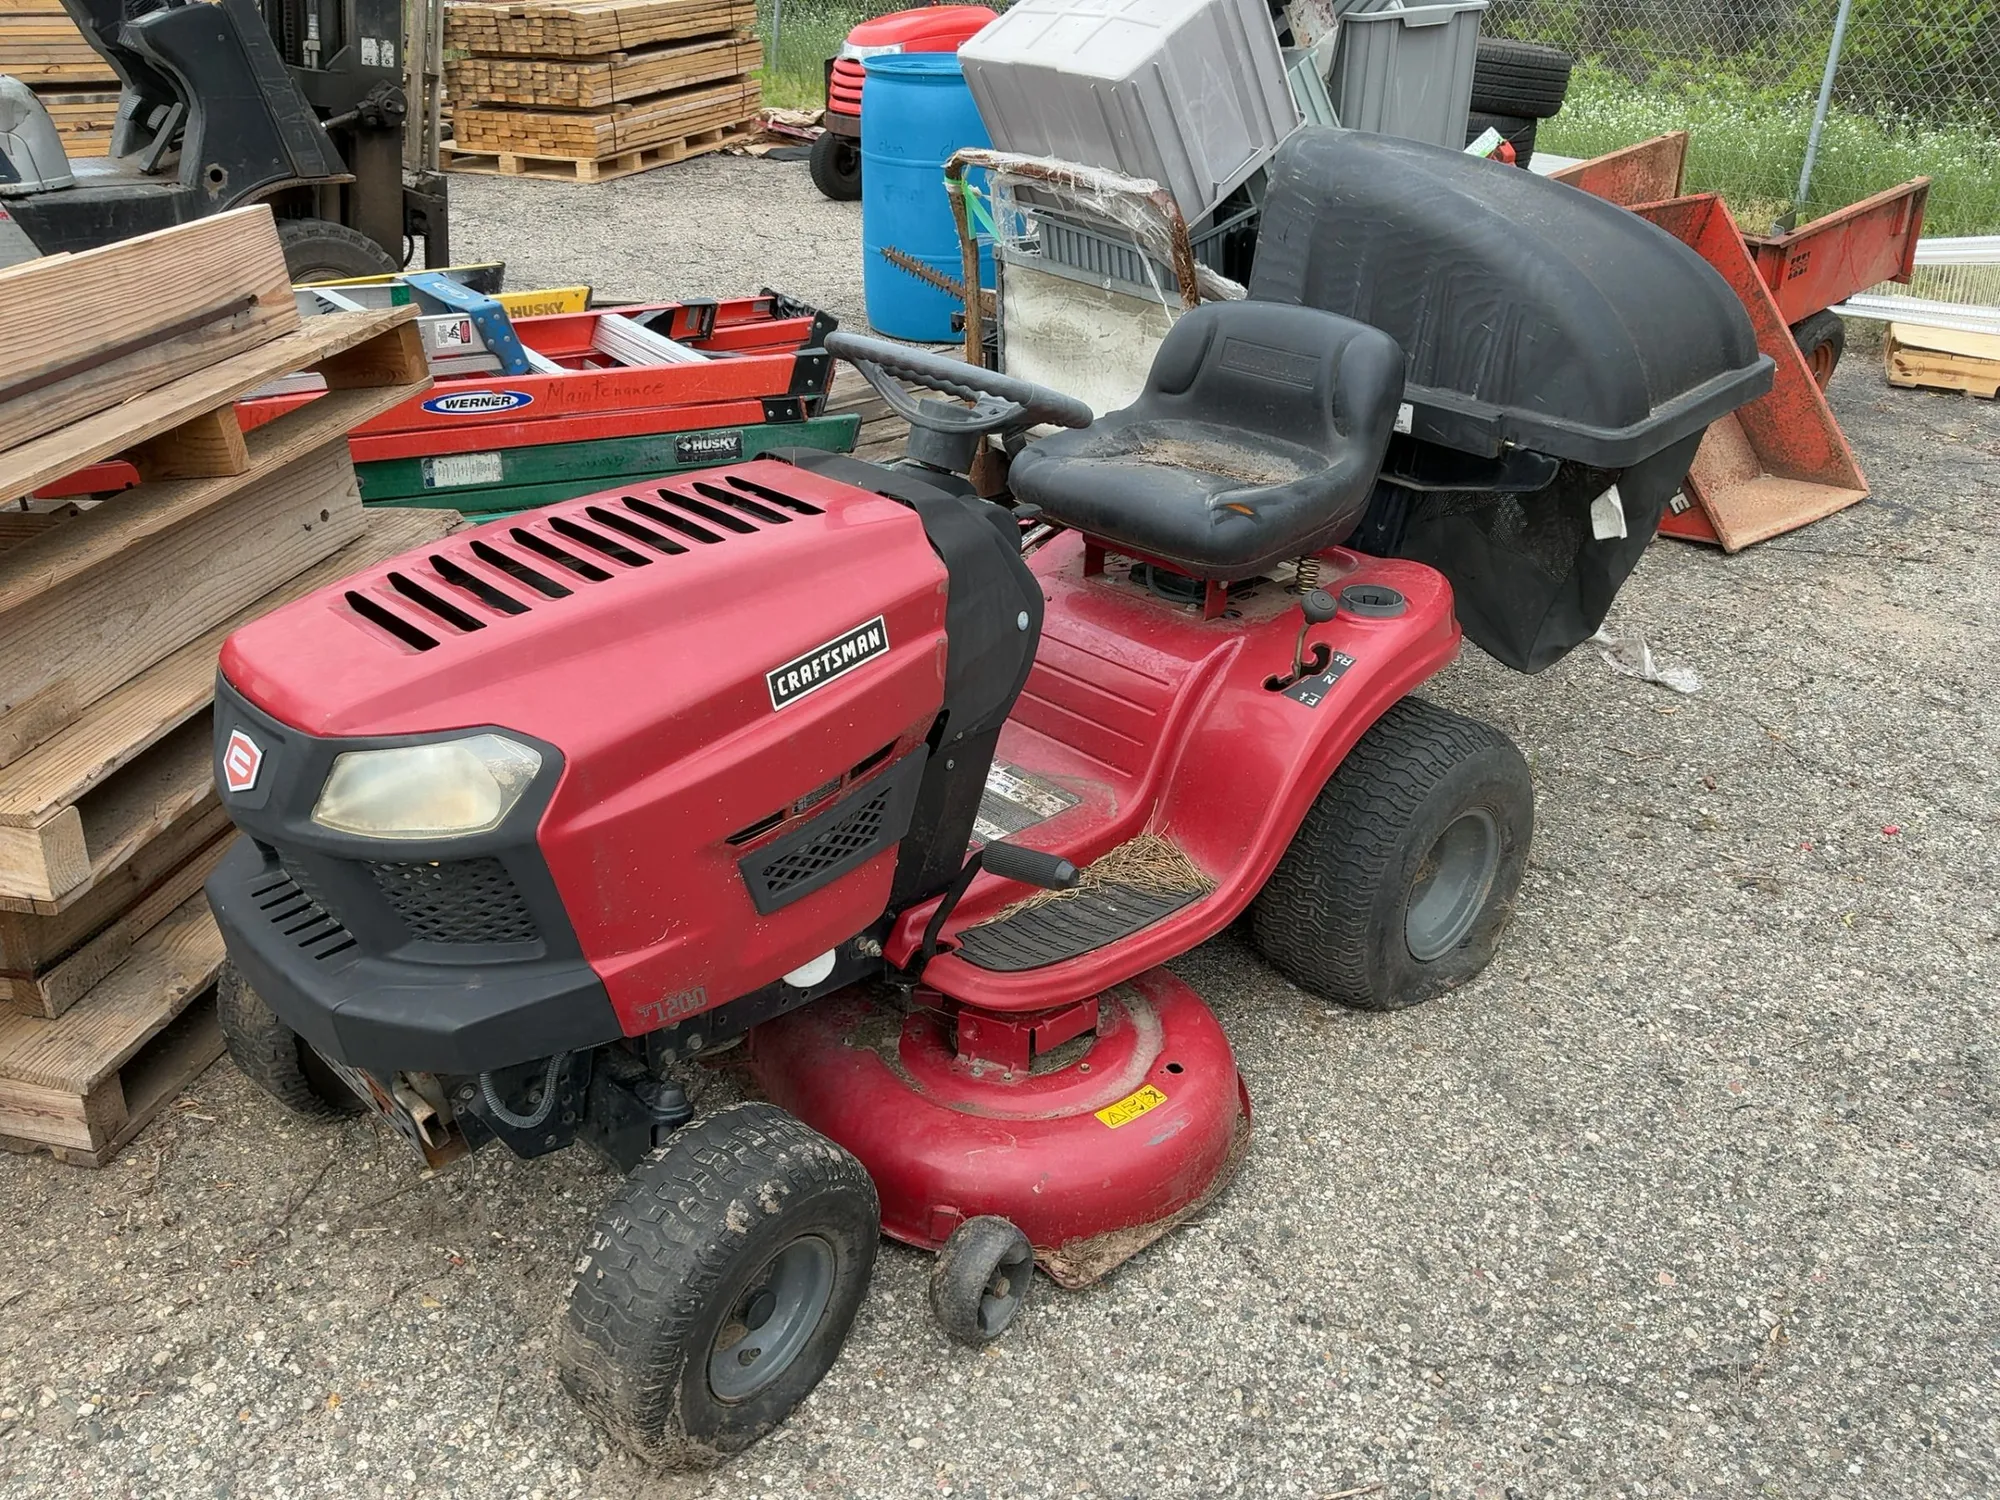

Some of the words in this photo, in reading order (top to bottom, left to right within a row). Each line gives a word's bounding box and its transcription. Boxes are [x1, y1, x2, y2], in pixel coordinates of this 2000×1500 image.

[511, 301, 564, 318] HUSKY
[544, 380, 665, 406] Maintenance
[445, 396, 512, 409] WERNER
[692, 437, 737, 450] HUSKY
[777, 628, 880, 696] CRAFTSMAN
[1340, 657, 1354, 667] R
[1322, 674, 1336, 685] N
[1306, 697, 1319, 706] F
[636, 987, 707, 1022] T1200
